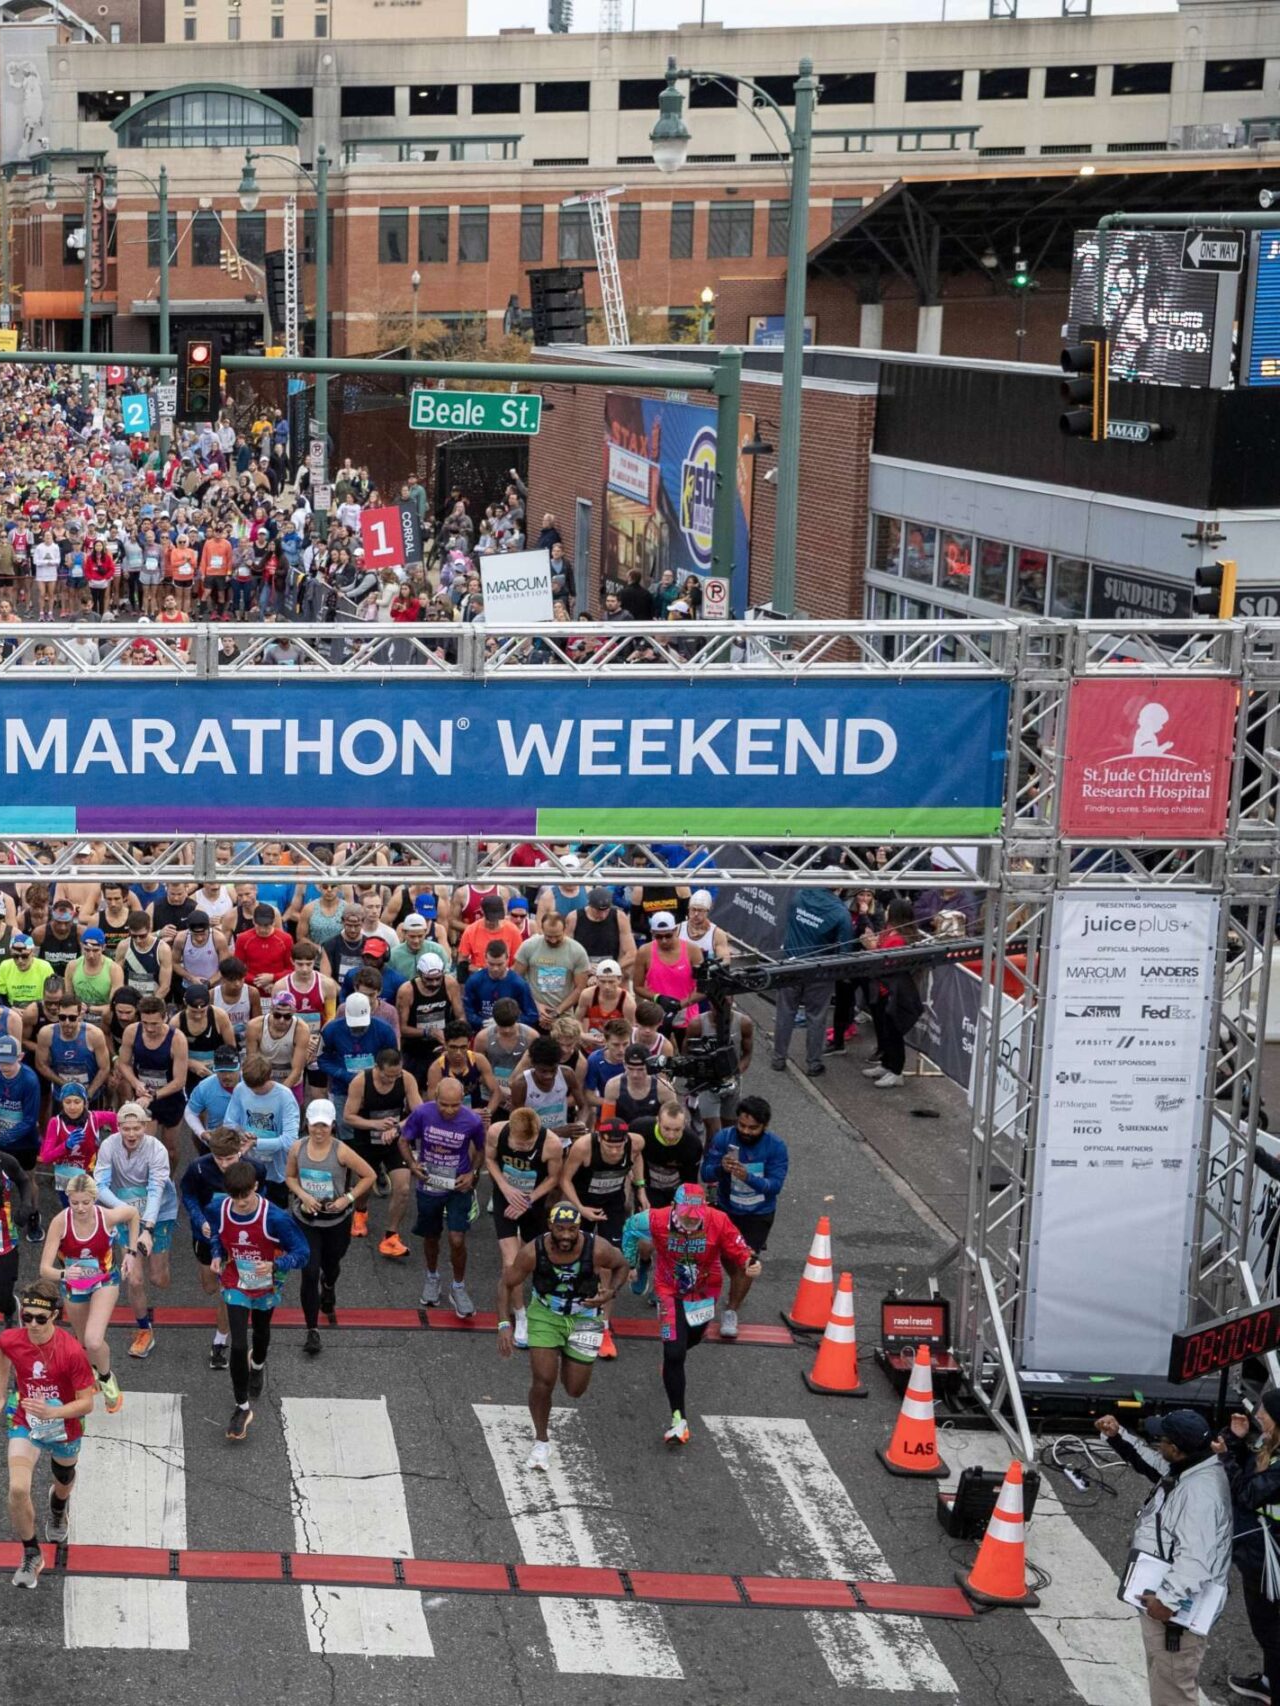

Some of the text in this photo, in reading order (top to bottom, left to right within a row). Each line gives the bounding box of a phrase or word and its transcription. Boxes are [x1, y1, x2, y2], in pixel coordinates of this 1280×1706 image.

[1200, 242, 1236, 261] ONE WAY
[128, 403, 145, 426] 2
[158, 401, 175, 412] 25
[416, 395, 536, 429] Beale St.
[611, 420, 649, 457] STAX
[1106, 424, 1144, 440] AMAR
[370, 521, 394, 557] 1
[401, 511, 416, 557] CORRAL
[486, 576, 548, 595] MARCUM
[486, 589, 549, 602] FOUNDATION
[1104, 577, 1177, 615] SUNDRIES
[497, 718, 897, 775] WEEKEND
[1083, 768, 1212, 784] St. Jude Children's
[1082, 784, 1210, 802] Research Hospital
[1084, 805, 1115, 813] Finding
[1142, 805, 1169, 814] Saving
[1171, 805, 1205, 814] children.
[796, 907, 824, 925] Volunteer
[1066, 966, 1126, 978] MARCUM
[1140, 966, 1199, 978] LANDERS
[1086, 1005, 1120, 1017] Shaw
[1141, 1005, 1191, 1020] FedEx
[1073, 1126, 1102, 1134] HICO
[667, 1245, 706, 1253] HERO
[904, 1441, 934, 1455] LAS
